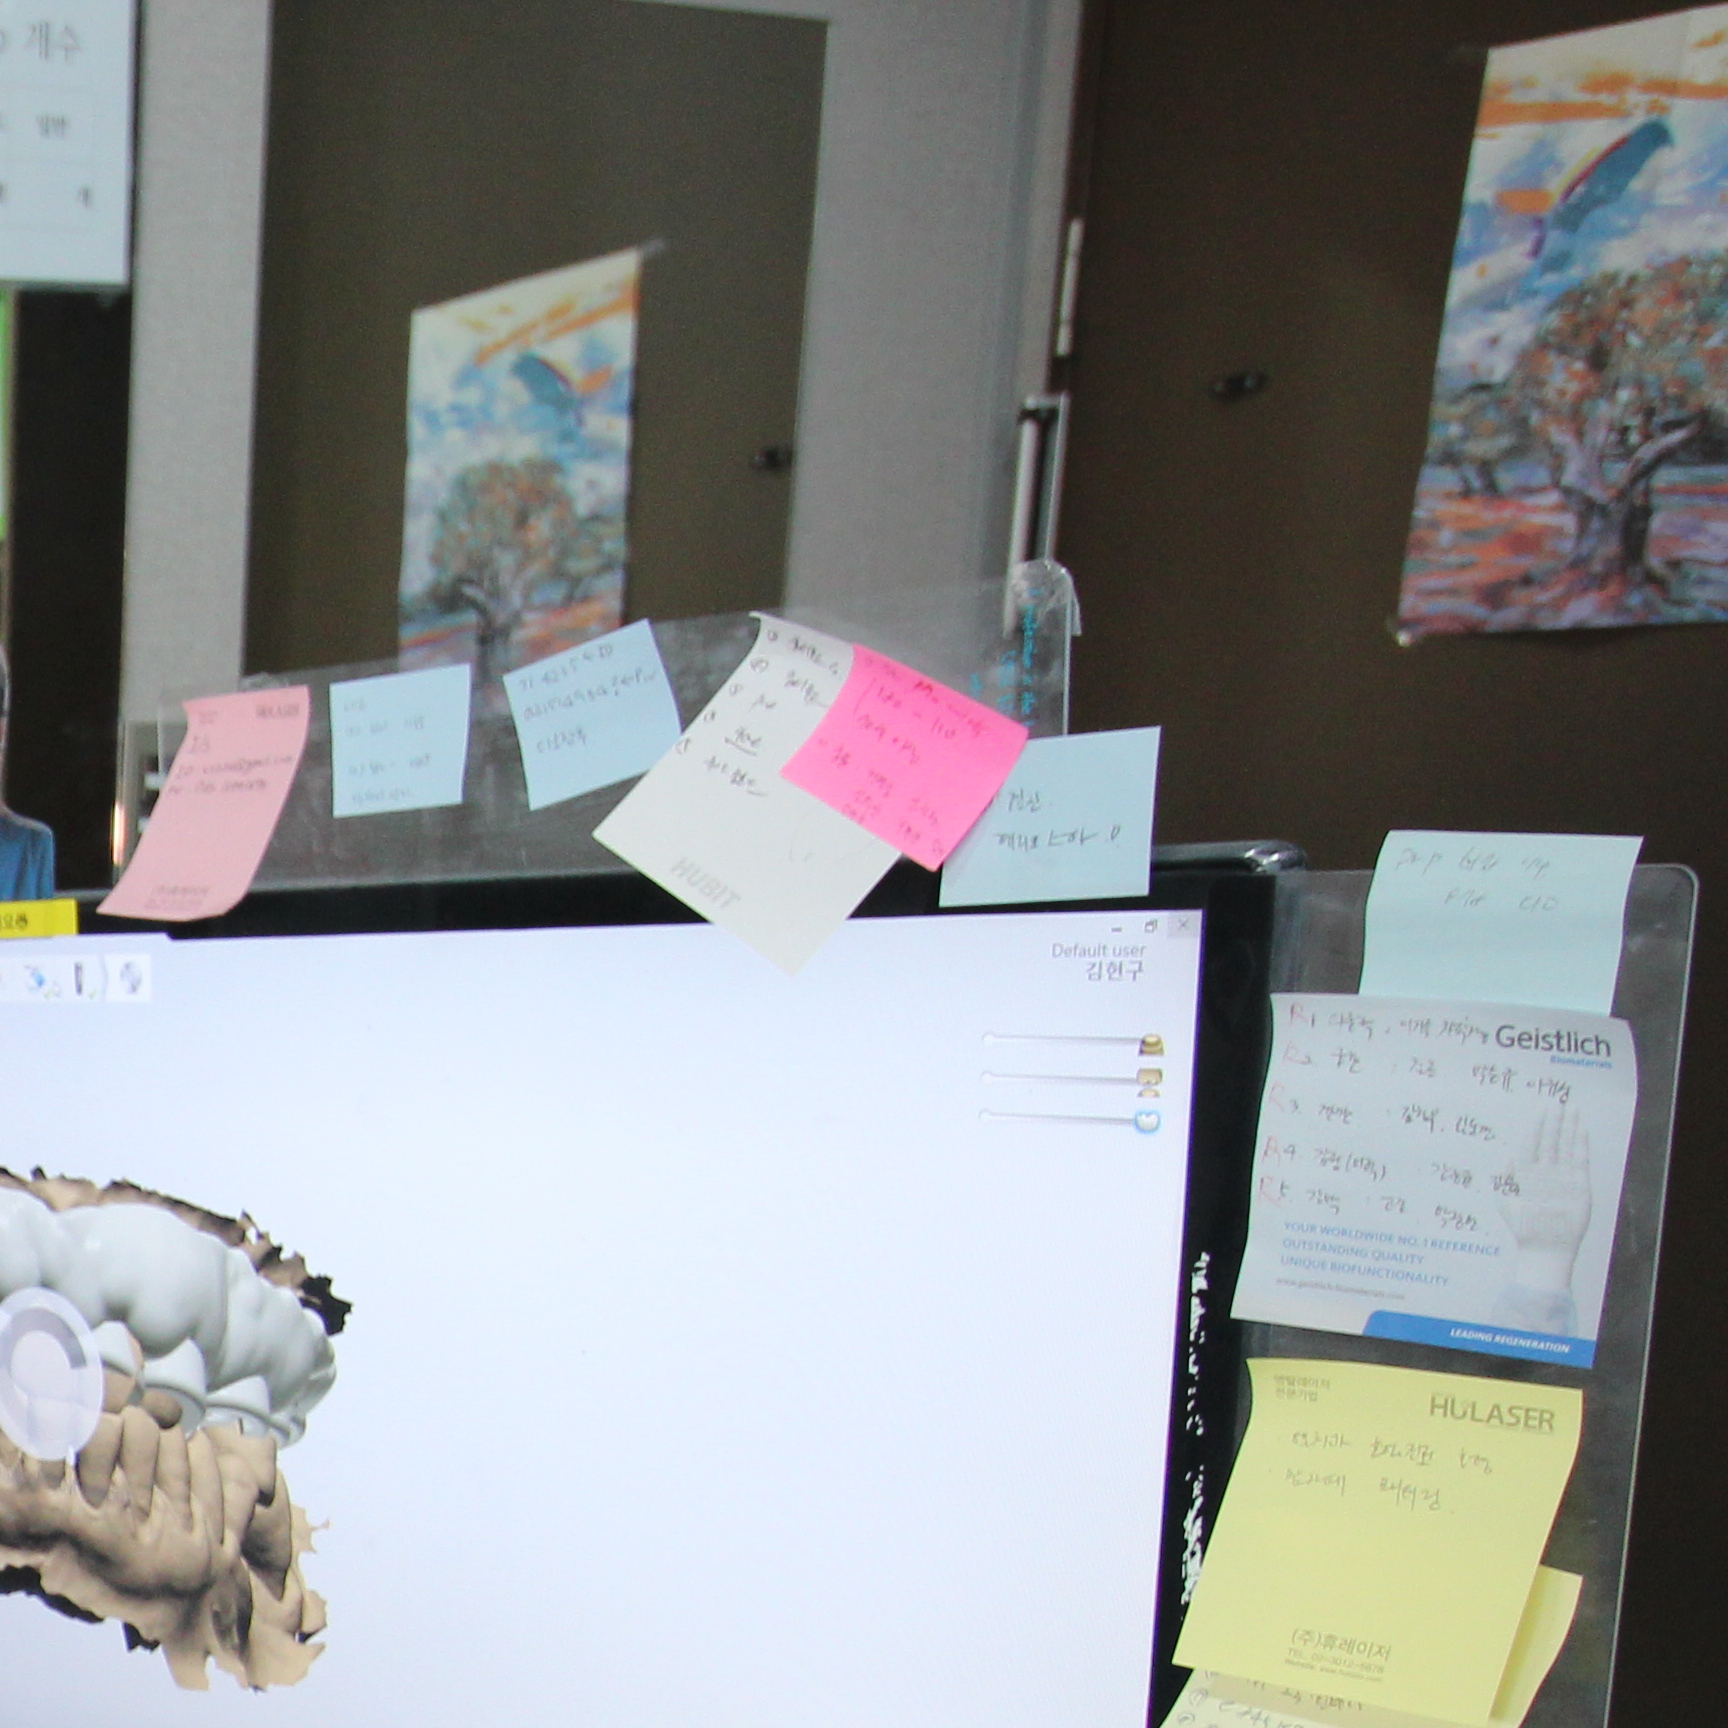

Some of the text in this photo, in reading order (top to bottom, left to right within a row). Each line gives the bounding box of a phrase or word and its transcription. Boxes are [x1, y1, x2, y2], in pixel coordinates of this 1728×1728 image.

[670, 857, 742, 909] HUBIT
[1051, 942, 1146, 959] Default user
[1085, 959, 1145, 983] 김현구
[1494, 1023, 1612, 1058] Geistlich
[1282, 1238, 1425, 1267] OUTSTANDING QUALITY
[1284, 1219, 1318, 1235] YOUR
[1429, 1238, 1501, 1257] REFERENCE
[1450, 1328, 1571, 1354] LEADING REGENERATION
[1429, 1394, 1556, 1434] HULASER
[1290, 1626, 1392, 1664] (주)휴레이저
